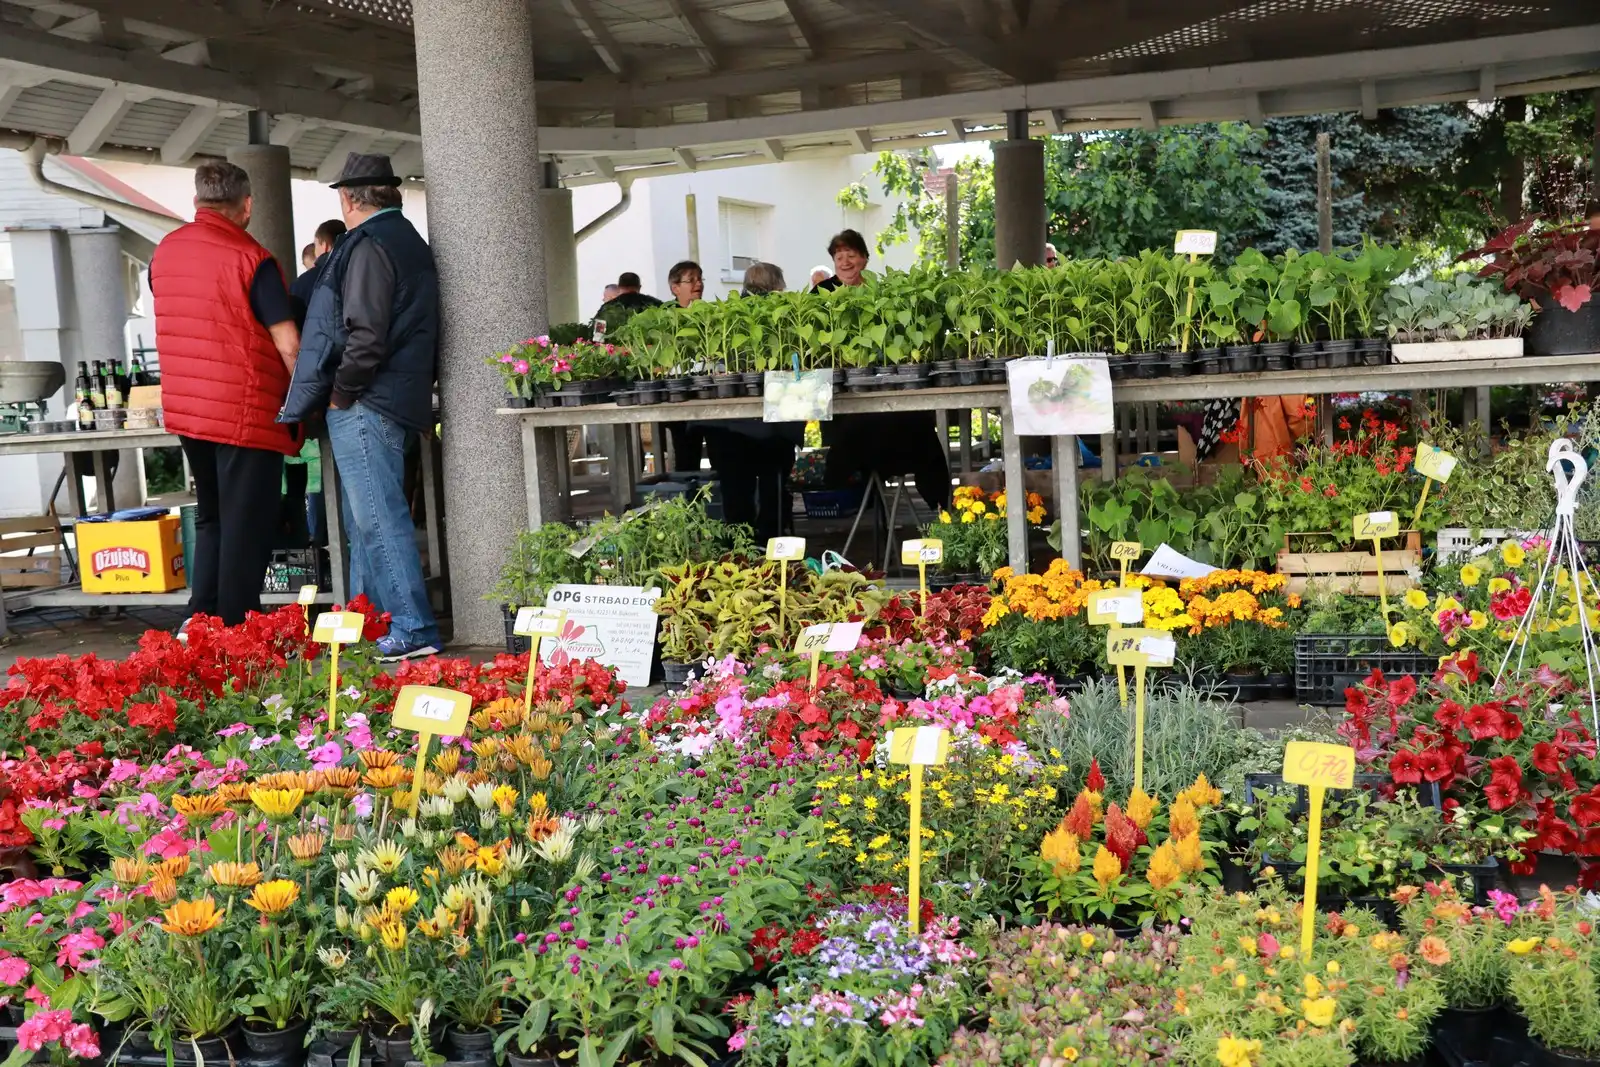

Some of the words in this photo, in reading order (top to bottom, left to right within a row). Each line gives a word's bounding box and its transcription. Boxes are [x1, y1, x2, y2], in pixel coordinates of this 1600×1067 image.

[95, 549, 146, 571] Ožujsko
[553, 591, 582, 603] OPG
[584, 595, 629, 605] STRBAD
